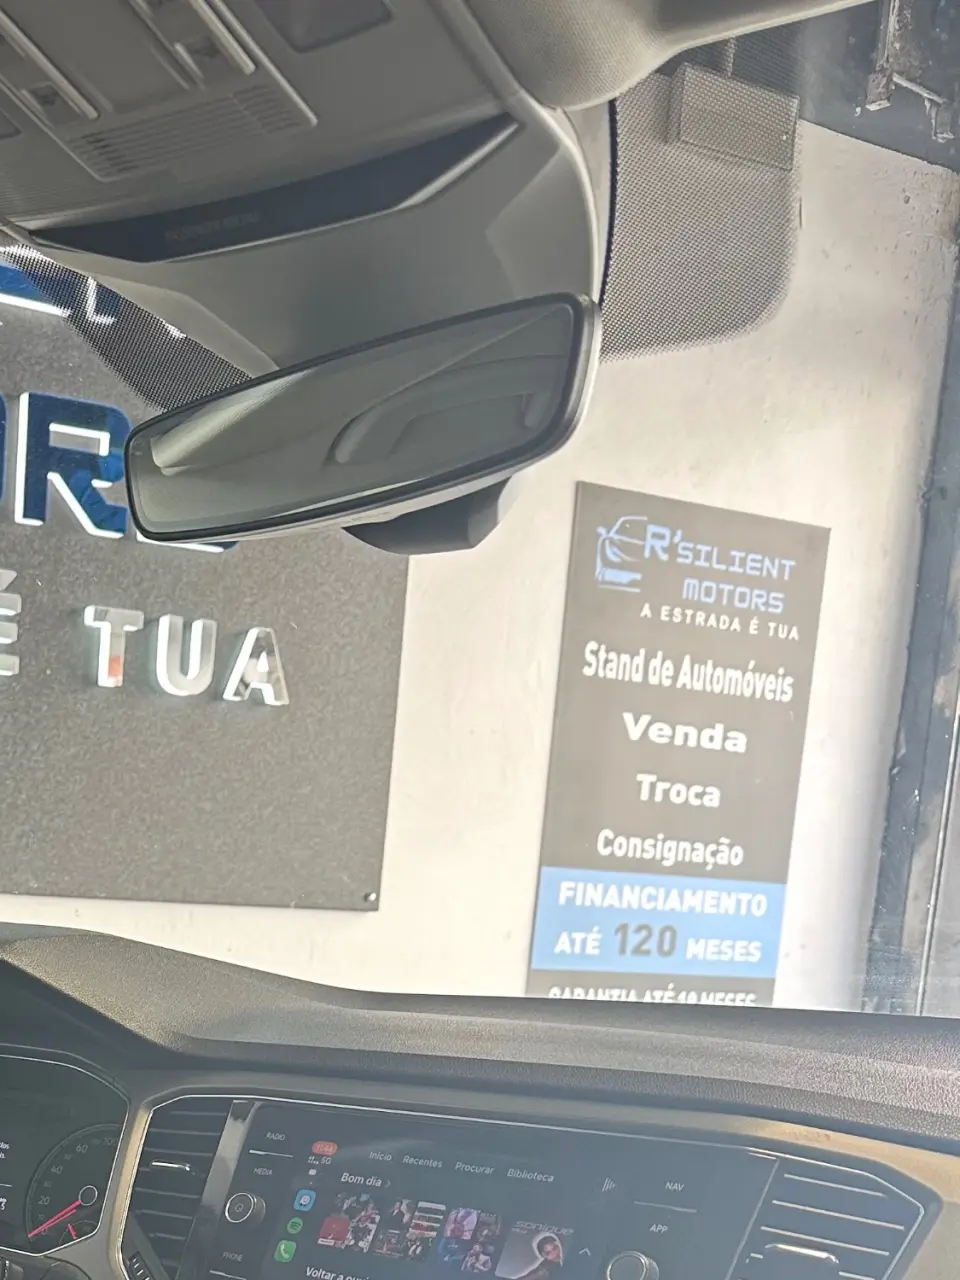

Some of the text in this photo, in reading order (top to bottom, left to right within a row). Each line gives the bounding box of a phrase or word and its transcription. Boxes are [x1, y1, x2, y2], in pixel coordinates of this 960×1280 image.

[683, 577, 785, 614] MOTORS
[640, 603, 799, 641] A ESTRADA É TUA
[84, 605, 290, 707] TUA
[583, 640, 794, 702] Stand de Automóveis
[622, 711, 748, 754] Venda
[636, 772, 721, 809] Troca
[597, 828, 744, 870] Consignação
[558, 880, 768, 917] FINANCIAMENTO
[554, 922, 763, 963] ATÉ 120 MESES
[75, 1144, 88, 1154] 60
[265, 1131, 286, 1141] RADIO
[253, 1167, 274, 1176] MEDIA
[320, 1156, 332, 1165] 5G
[402, 1154, 444, 1169] Recentes
[454, 1161, 496, 1176] Procurar
[506, 1168, 555, 1183] Biblioteca
[340, 1172, 382, 1188] Bom dia
[665, 1181, 685, 1192] NAV
[38, 1196, 50, 1205] 20
[649, 1223, 669, 1234] APP
[221, 1251, 244, 1262] PHONE
